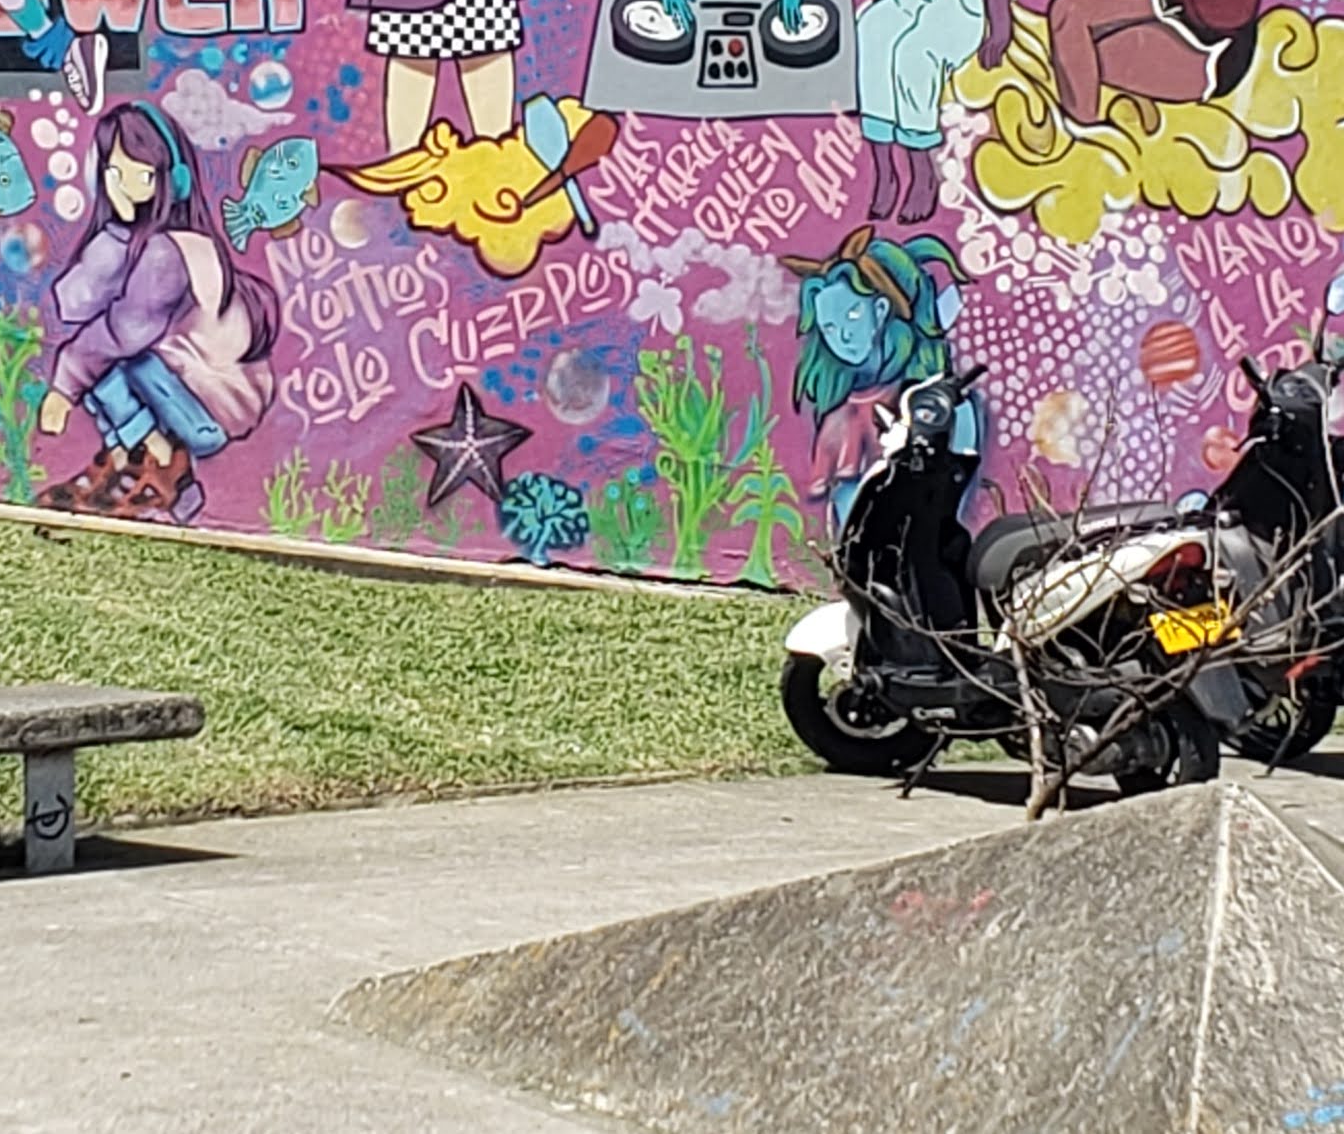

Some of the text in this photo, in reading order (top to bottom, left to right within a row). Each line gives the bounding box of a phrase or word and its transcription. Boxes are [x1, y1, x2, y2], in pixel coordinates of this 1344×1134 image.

[744, 188, 808, 252] NO
[1175, 216, 1339, 289] MANOS
[265, 227, 343, 296] NO
[282, 242, 450, 360] SOMOS
[1255, 267, 1308, 339] LA
[280, 249, 633, 438] SOLO CUERPOS
